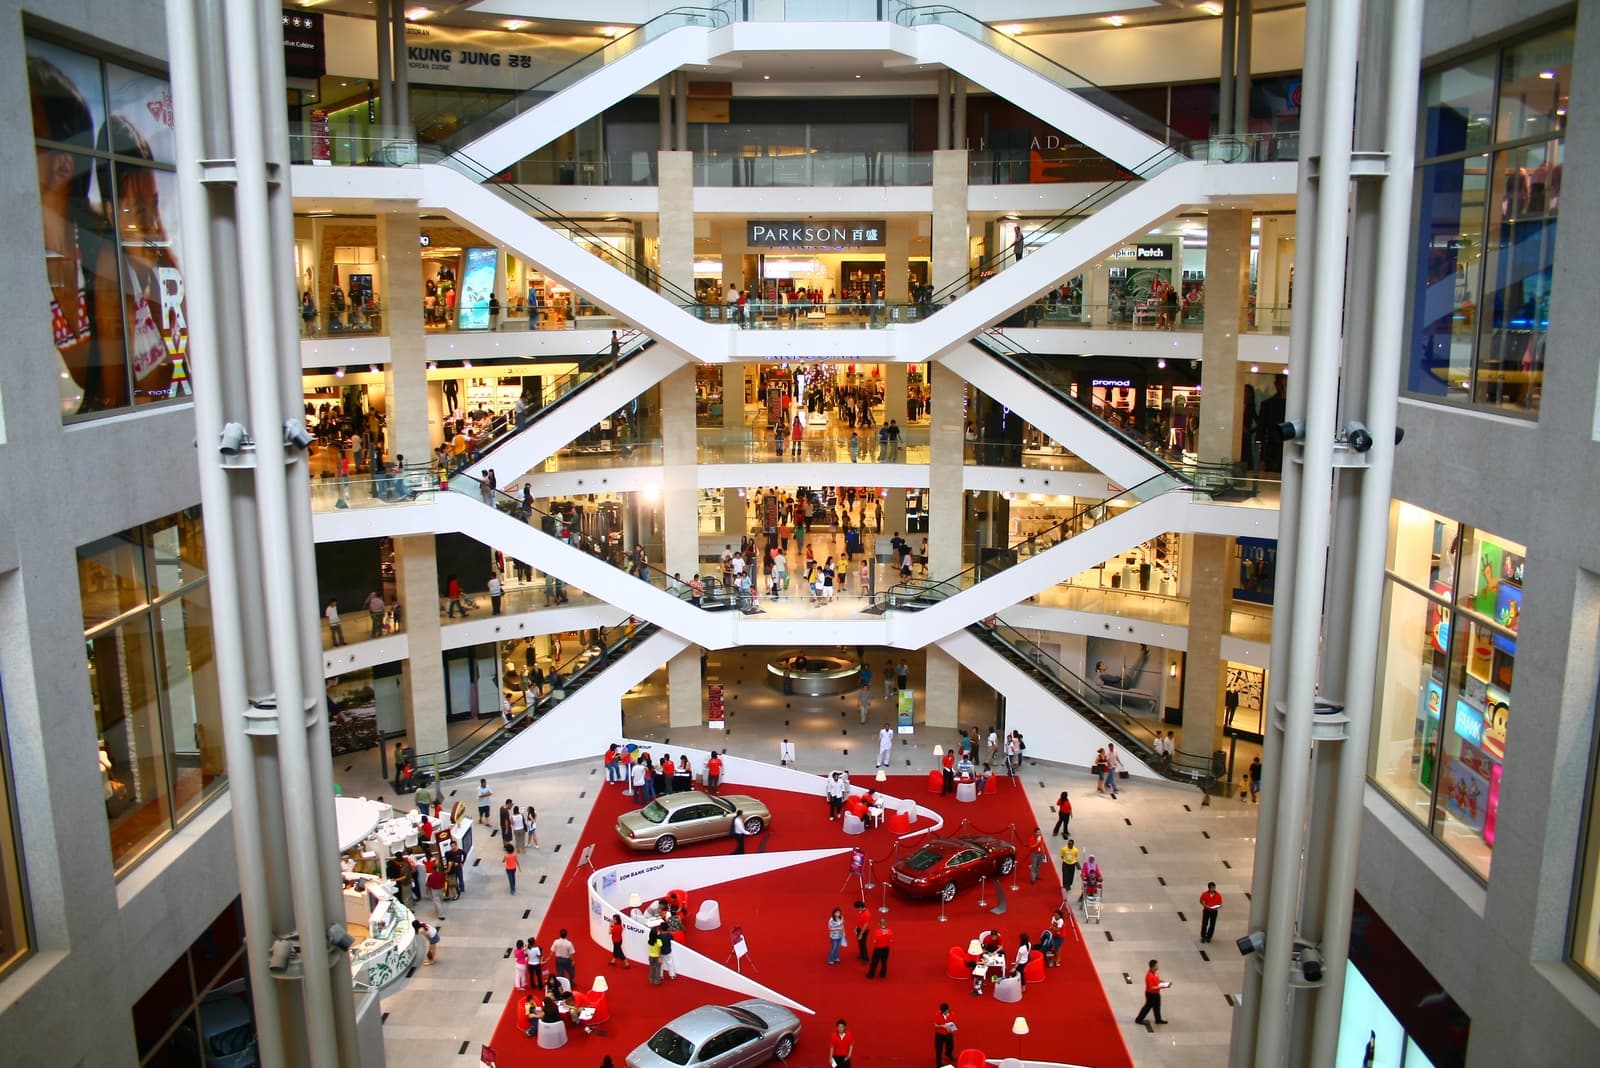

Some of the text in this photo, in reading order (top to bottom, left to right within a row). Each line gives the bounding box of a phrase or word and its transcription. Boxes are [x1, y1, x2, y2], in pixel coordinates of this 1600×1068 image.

[407, 46, 501, 66] KUNG JUNG
[753, 226, 846, 241] PARKSON
[852, 229, 878, 240] 百盛
[1138, 247, 1164, 257] Patch
[631, 869, 645, 878] BANK
[645, 863, 665, 873] GROUP
[626, 924, 645, 934] GROUP
